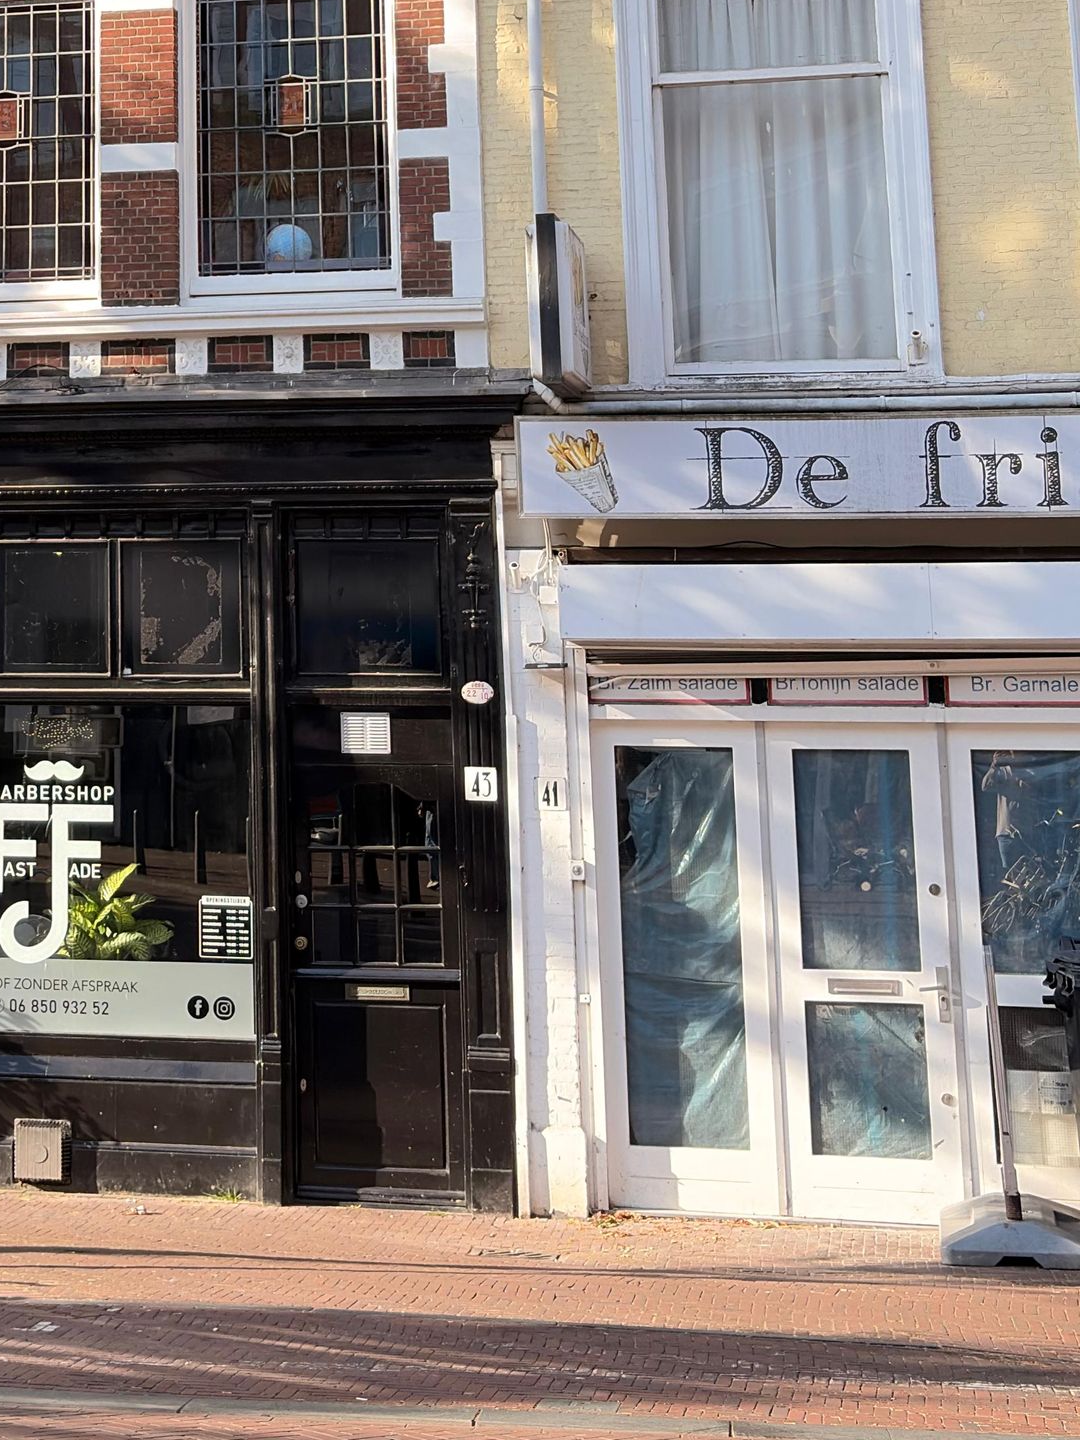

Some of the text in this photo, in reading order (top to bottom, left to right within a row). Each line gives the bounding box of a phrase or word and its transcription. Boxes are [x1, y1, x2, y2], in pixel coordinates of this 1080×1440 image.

[694, 427, 850, 511] De
[918, 420, 1071, 509] fri
[857, 676, 919, 690] salade
[971, 676, 996, 692] Br.
[471, 771, 492, 798] 43
[542, 781, 559, 807] 41
[13, 978, 68, 991] ZONDER
[71, 980, 138, 993] AFSPRAAK
[9, 998, 110, 1016] 06 850 932 52
